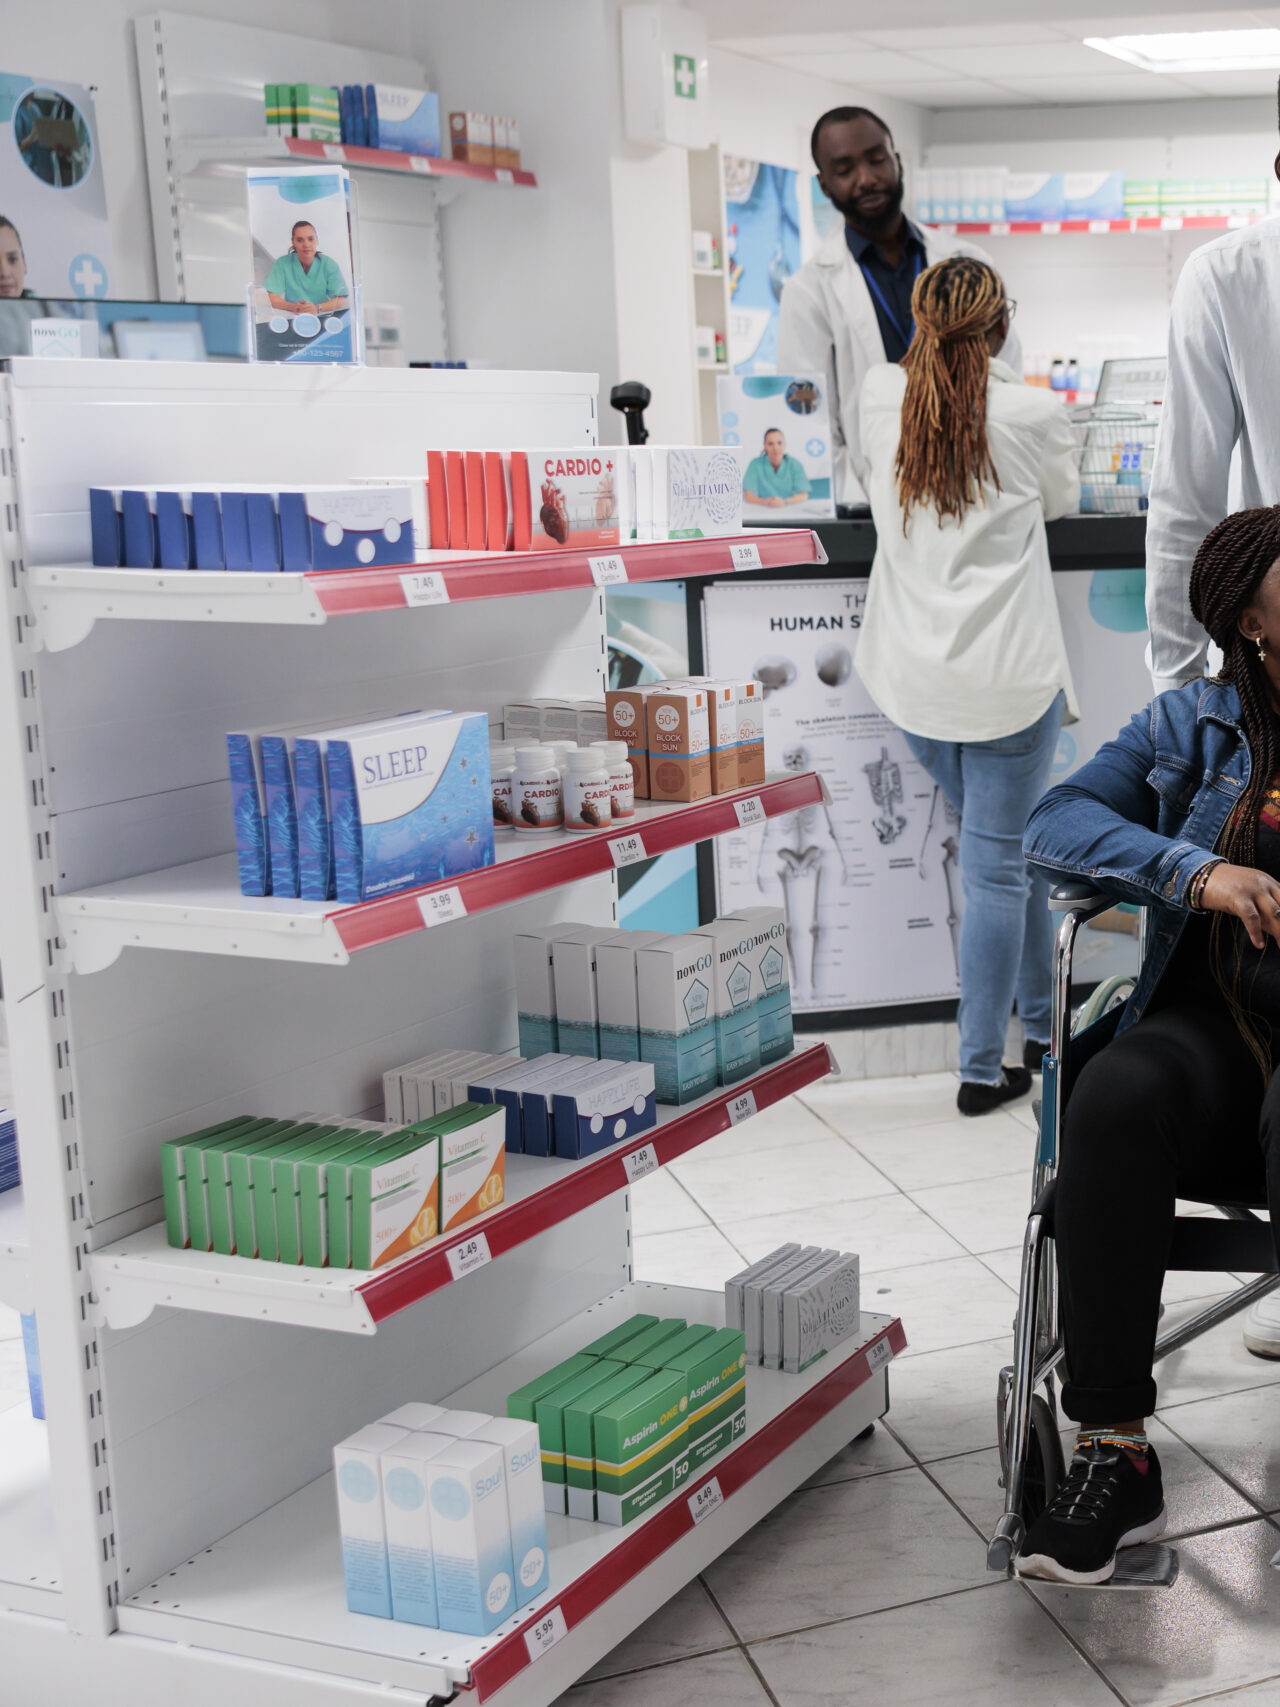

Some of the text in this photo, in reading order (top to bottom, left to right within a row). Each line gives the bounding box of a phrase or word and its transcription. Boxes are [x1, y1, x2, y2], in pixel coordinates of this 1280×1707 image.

[544, 458, 602, 477] CARDIO
[596, 560, 617, 572] 11.49
[412, 576, 434, 589] 7.49
[842, 594, 867, 608] TH
[770, 616, 844, 632] HUMAN
[616, 710, 634, 721] 50+
[658, 714, 678, 726] 50+
[656, 734, 682, 742] BLOCK
[362, 745, 428, 784] SLEEP
[742, 800, 756, 814] 2.20
[616, 838, 637, 854] 11.49
[430, 893, 451, 908] 3.99
[720, 938, 754, 963] nowGO
[676, 954, 712, 980] nowGO
[735, 1098, 748, 1112] 4.99
[448, 1131, 487, 1156] Vitamin C
[632, 1150, 648, 1166] 7.49
[376, 1170, 410, 1190] Vitamin
[458, 1242, 478, 1260] 2.49
[689, 1361, 738, 1400] Aspirin ONE
[622, 1422, 658, 1450] Aspirin
[659, 1404, 678, 1426] ONE
[734, 1416, 746, 1434] 30
[512, 1441, 538, 1472] Soul
[675, 1461, 689, 1480] 30
[475, 1464, 502, 1497] Soul
[697, 1486, 712, 1504] 8.49
[523, 1558, 542, 1580] 50+
[489, 1584, 507, 1606] 50+
[535, 1618, 554, 1640] 5.99
